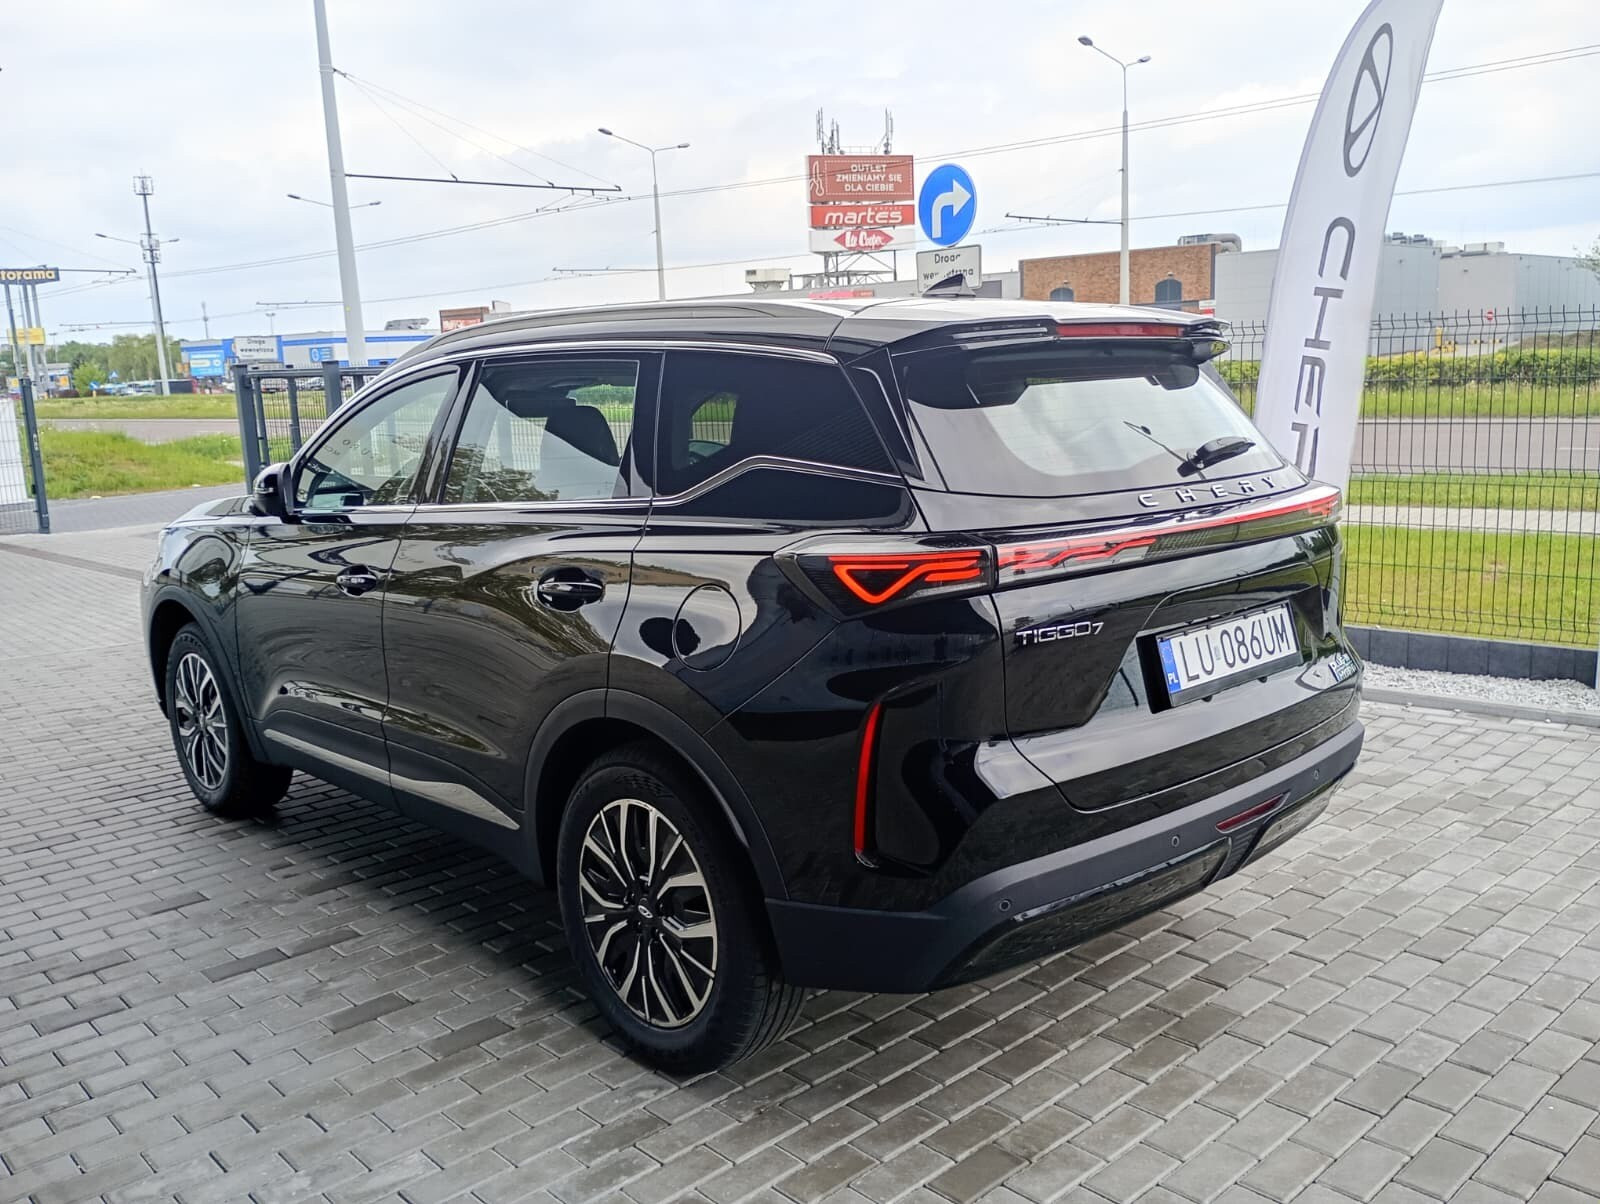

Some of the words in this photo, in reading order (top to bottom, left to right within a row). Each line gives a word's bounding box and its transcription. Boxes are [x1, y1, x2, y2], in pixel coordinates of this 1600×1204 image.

[850, 164, 887, 172] OUTLET
[835, 174, 885, 183] ZMIENIAMY
[888, 174, 903, 183] SIĘ
[844, 183, 863, 192] DLA
[865, 183, 895, 192] CIEBIE
[824, 207, 903, 225] martes
[1138, 476, 1276, 508] CHERY
[1179, 634, 1215, 682] LU
[1219, 613, 1291, 668] 086UM
[1167, 671, 1179, 685] PL
